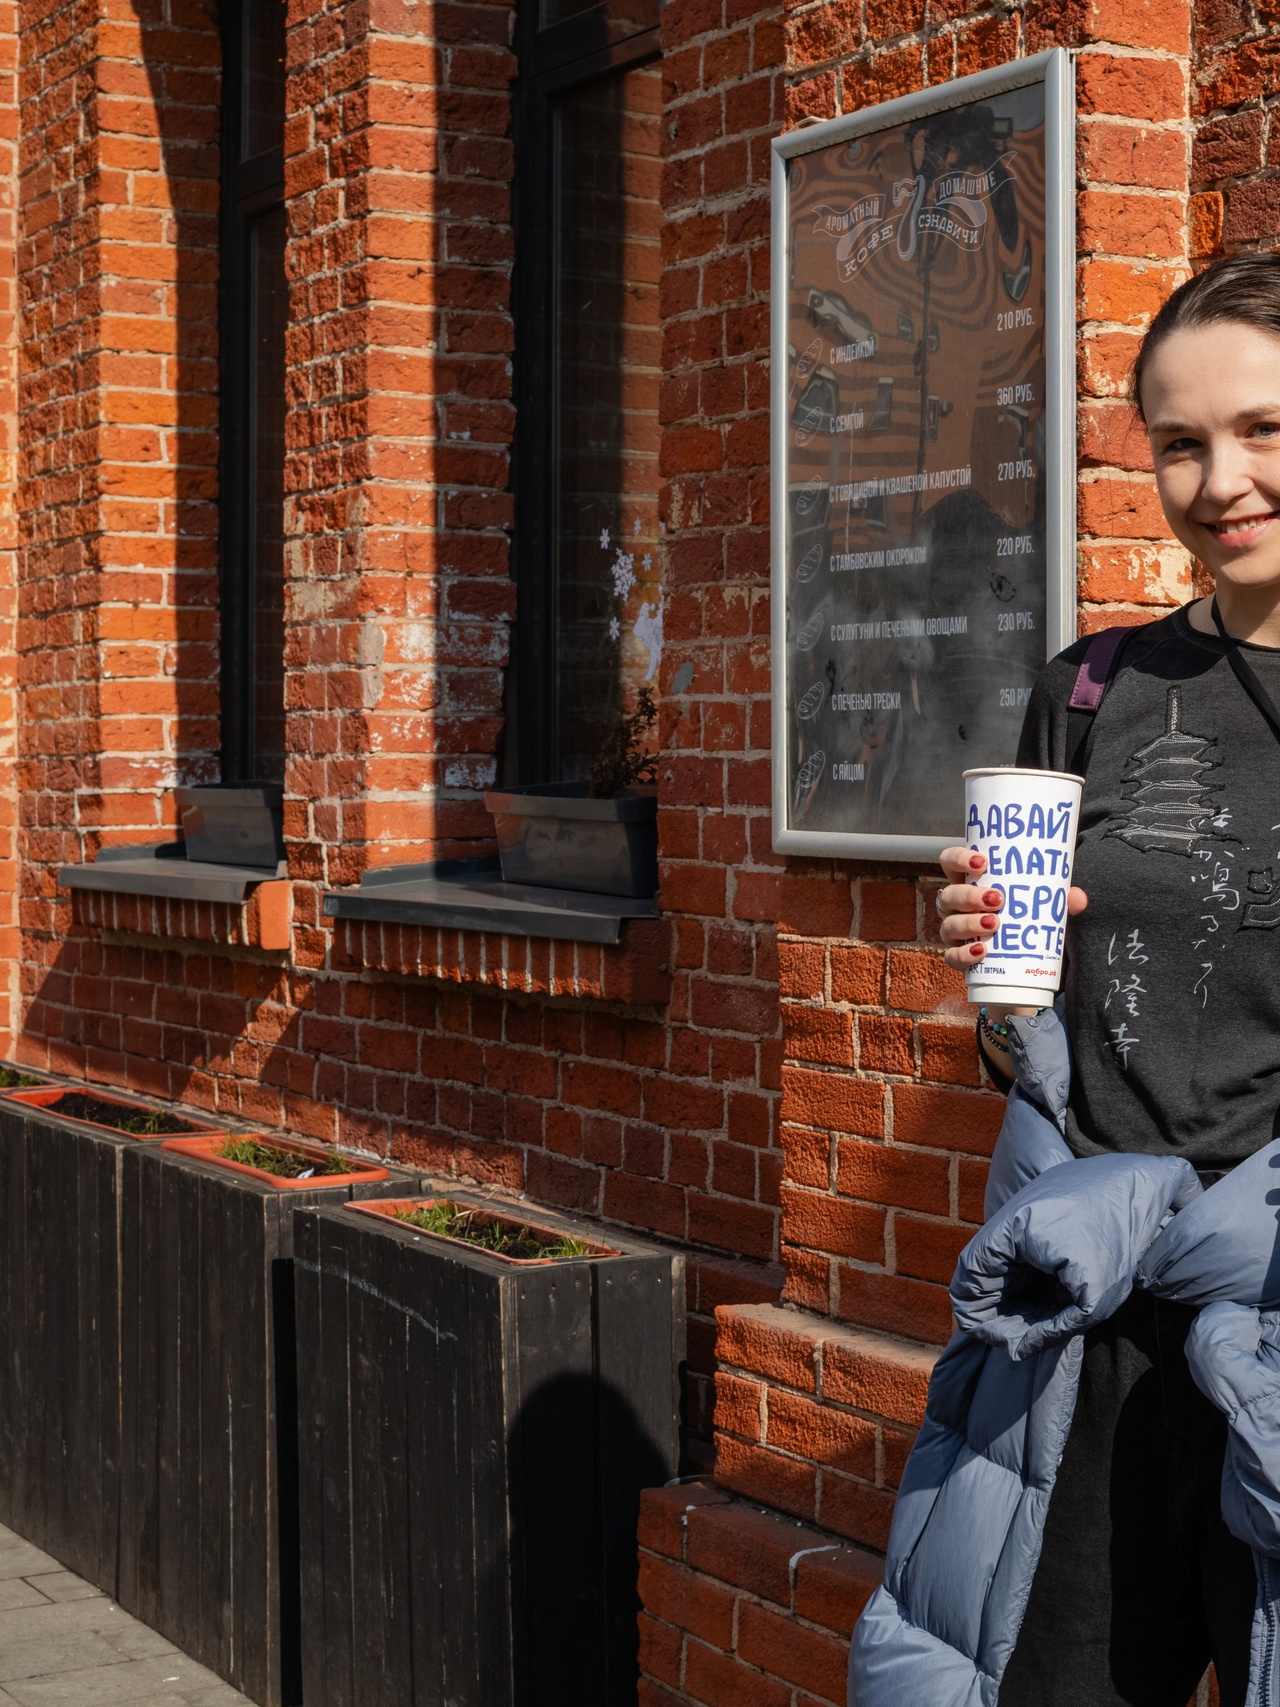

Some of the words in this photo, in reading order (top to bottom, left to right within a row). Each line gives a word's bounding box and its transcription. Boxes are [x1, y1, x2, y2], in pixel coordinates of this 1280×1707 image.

[939, 171, 997, 199] ДОМАШНИЕ
[825, 197, 880, 231] АРОМАТНЫЙ
[918, 214, 978, 243] СЭНДВИЧИ
[844, 225, 893, 276] КОФЕ
[997, 311, 1014, 331] 210
[1015, 308, 1035, 327] РУБ.
[830, 348, 836, 364] С
[836, 336, 875, 363] ИНДЕЙКОЙ
[997, 386, 1014, 406] 360
[1015, 384, 1035, 403] РУБ.
[830, 417, 835, 433] С
[836, 409, 864, 432] СЕМГОЙ
[829, 486, 835, 502] С
[835, 477, 878, 501] ГОВЯДИНОЙ
[879, 479, 885, 495] И
[886, 470, 928, 495] КВАШЕНОЙ
[929, 464, 972, 489] КАПУСТОЙ
[998, 462, 1014, 481] 270
[1016, 460, 1035, 478] РУБ.
[830, 555, 835, 572] С
[836, 550, 885, 571] ТАМБОВСКИМ
[886, 546, 927, 566] ОКОРОКОМ
[997, 538, 1014, 556] 220
[1015, 536, 1035, 554] РУБ.
[830, 625, 836, 642] С
[836, 622, 874, 641] СУЛУГУНИ
[875, 623, 881, 639] И
[926, 616, 968, 637] ОВОЩАМИ
[998, 613, 1015, 631] 230
[1016, 611, 1036, 631] РУБ.
[831, 694, 837, 711] С
[837, 692, 872, 710] ПЕЧЕНЬЮ
[872, 692, 901, 710] ТРЕСКИ
[1000, 689, 1015, 706] 250
[1017, 688, 1033, 706] РУ
[832, 763, 838, 780] С
[839, 760, 865, 782] ЯЙЦОМ
[967, 801, 1073, 843] ДАВАЙ
[970, 845, 1069, 879] ЕЛАТЬ
[970, 882, 1066, 923] ОБРО
[967, 924, 1064, 956] ЕСТЕ
[1025, 968, 1057, 977] добро.рф
